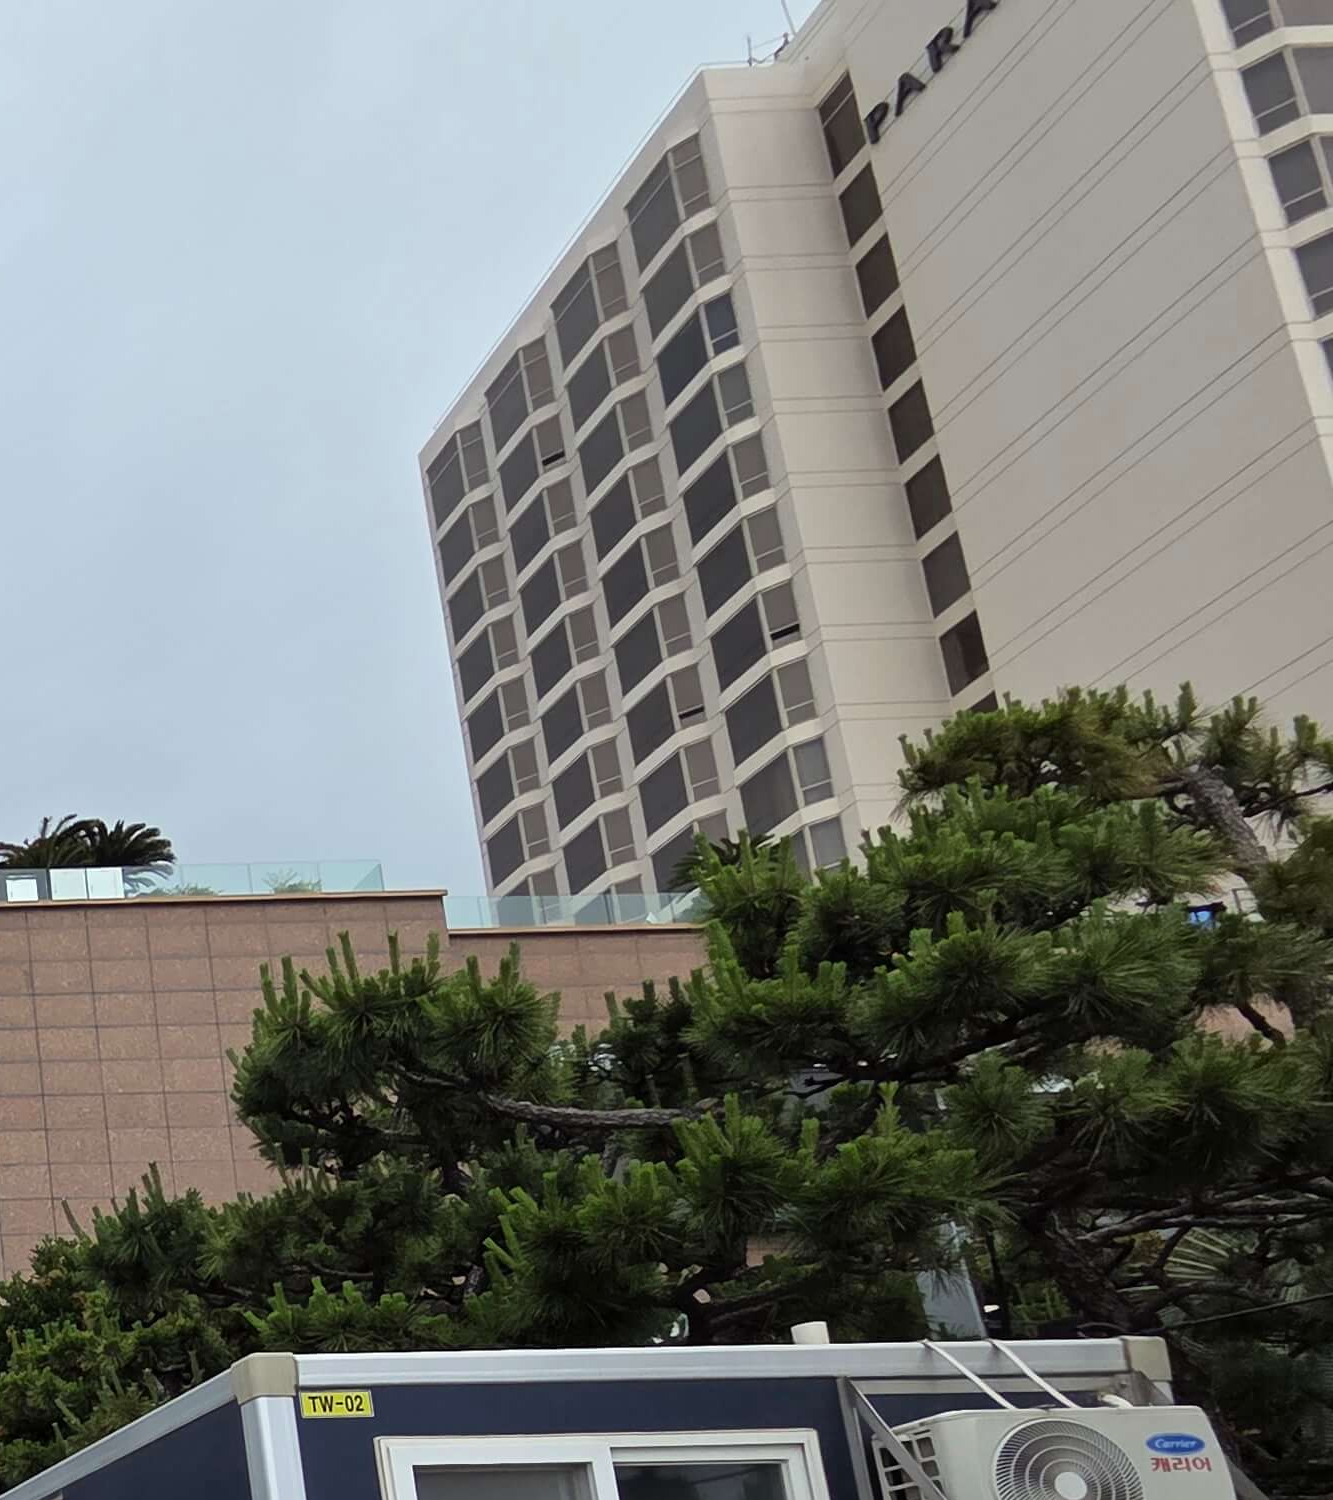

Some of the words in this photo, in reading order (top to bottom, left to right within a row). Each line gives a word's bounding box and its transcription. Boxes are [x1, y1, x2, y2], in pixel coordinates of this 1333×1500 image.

[308, 1395, 365, 1413] TW-02
[1155, 1438, 1198, 1449] Carrier
[1150, 1456, 1212, 1473] 캐리어
